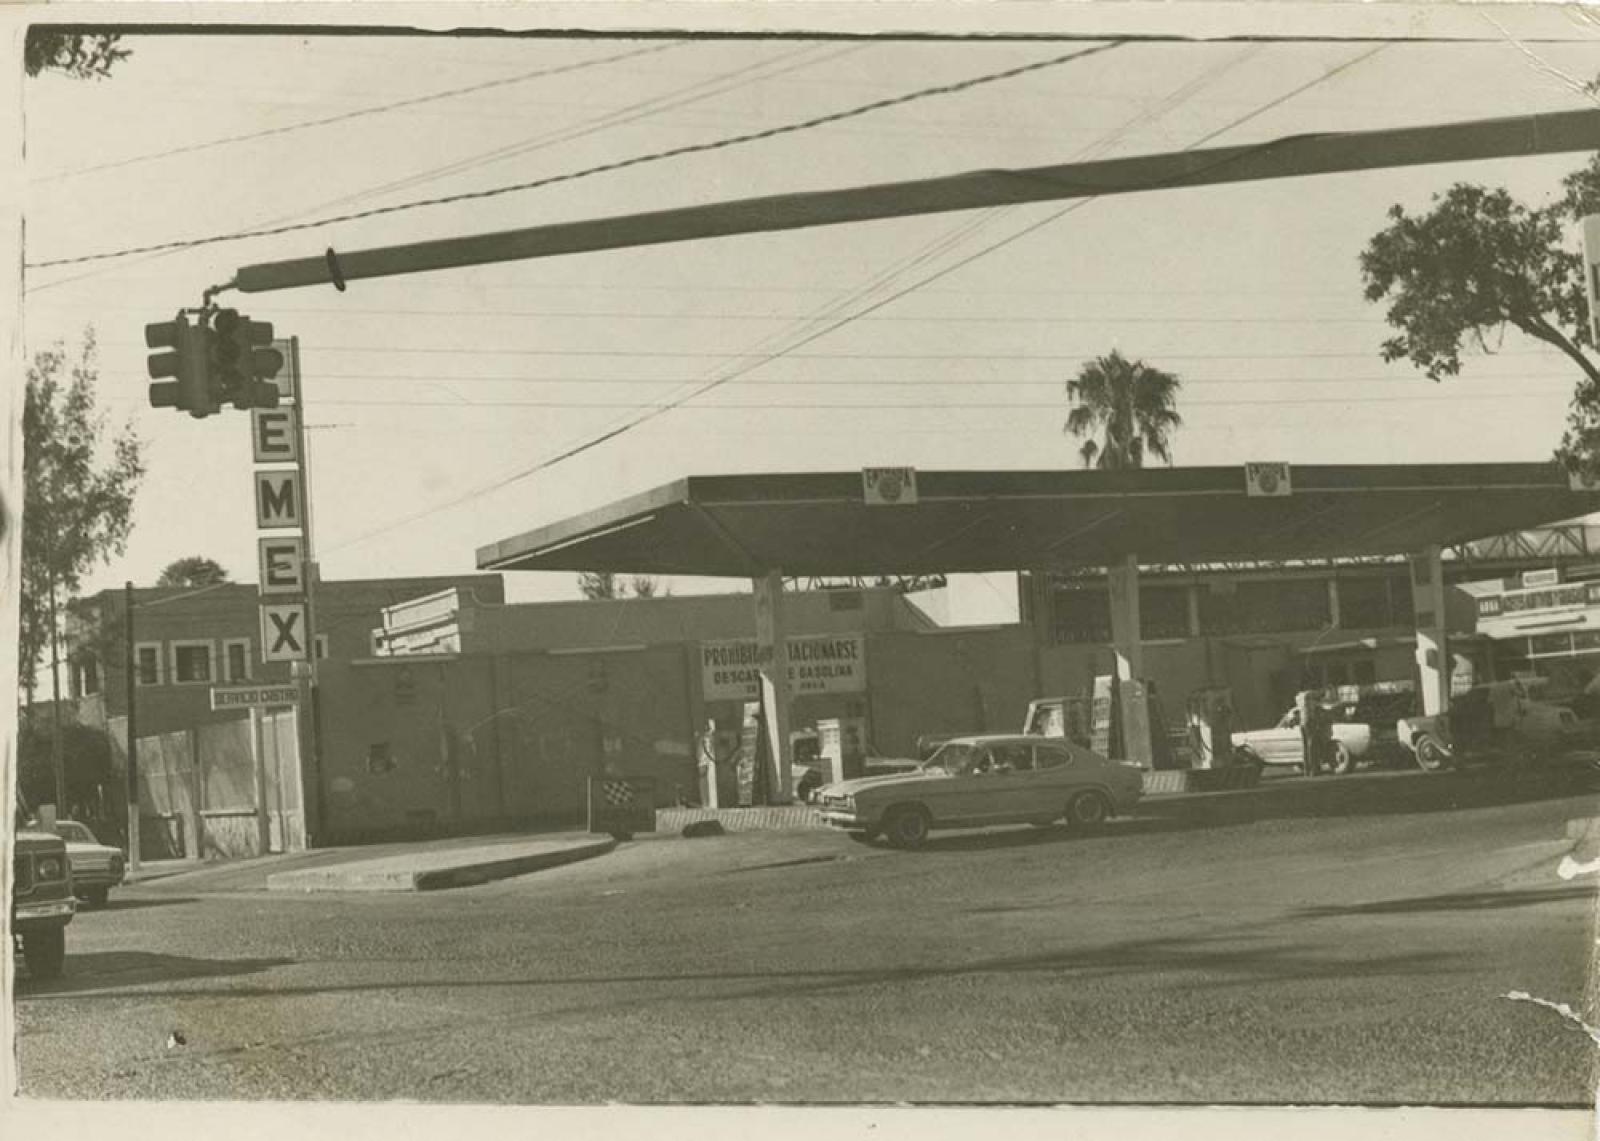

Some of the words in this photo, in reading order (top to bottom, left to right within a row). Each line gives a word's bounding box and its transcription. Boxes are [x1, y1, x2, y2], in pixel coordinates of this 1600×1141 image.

[258, 413, 302, 652] EMEX
[787, 639, 858, 661] TACIONARSE
[714, 670, 760, 684] DESCAR
